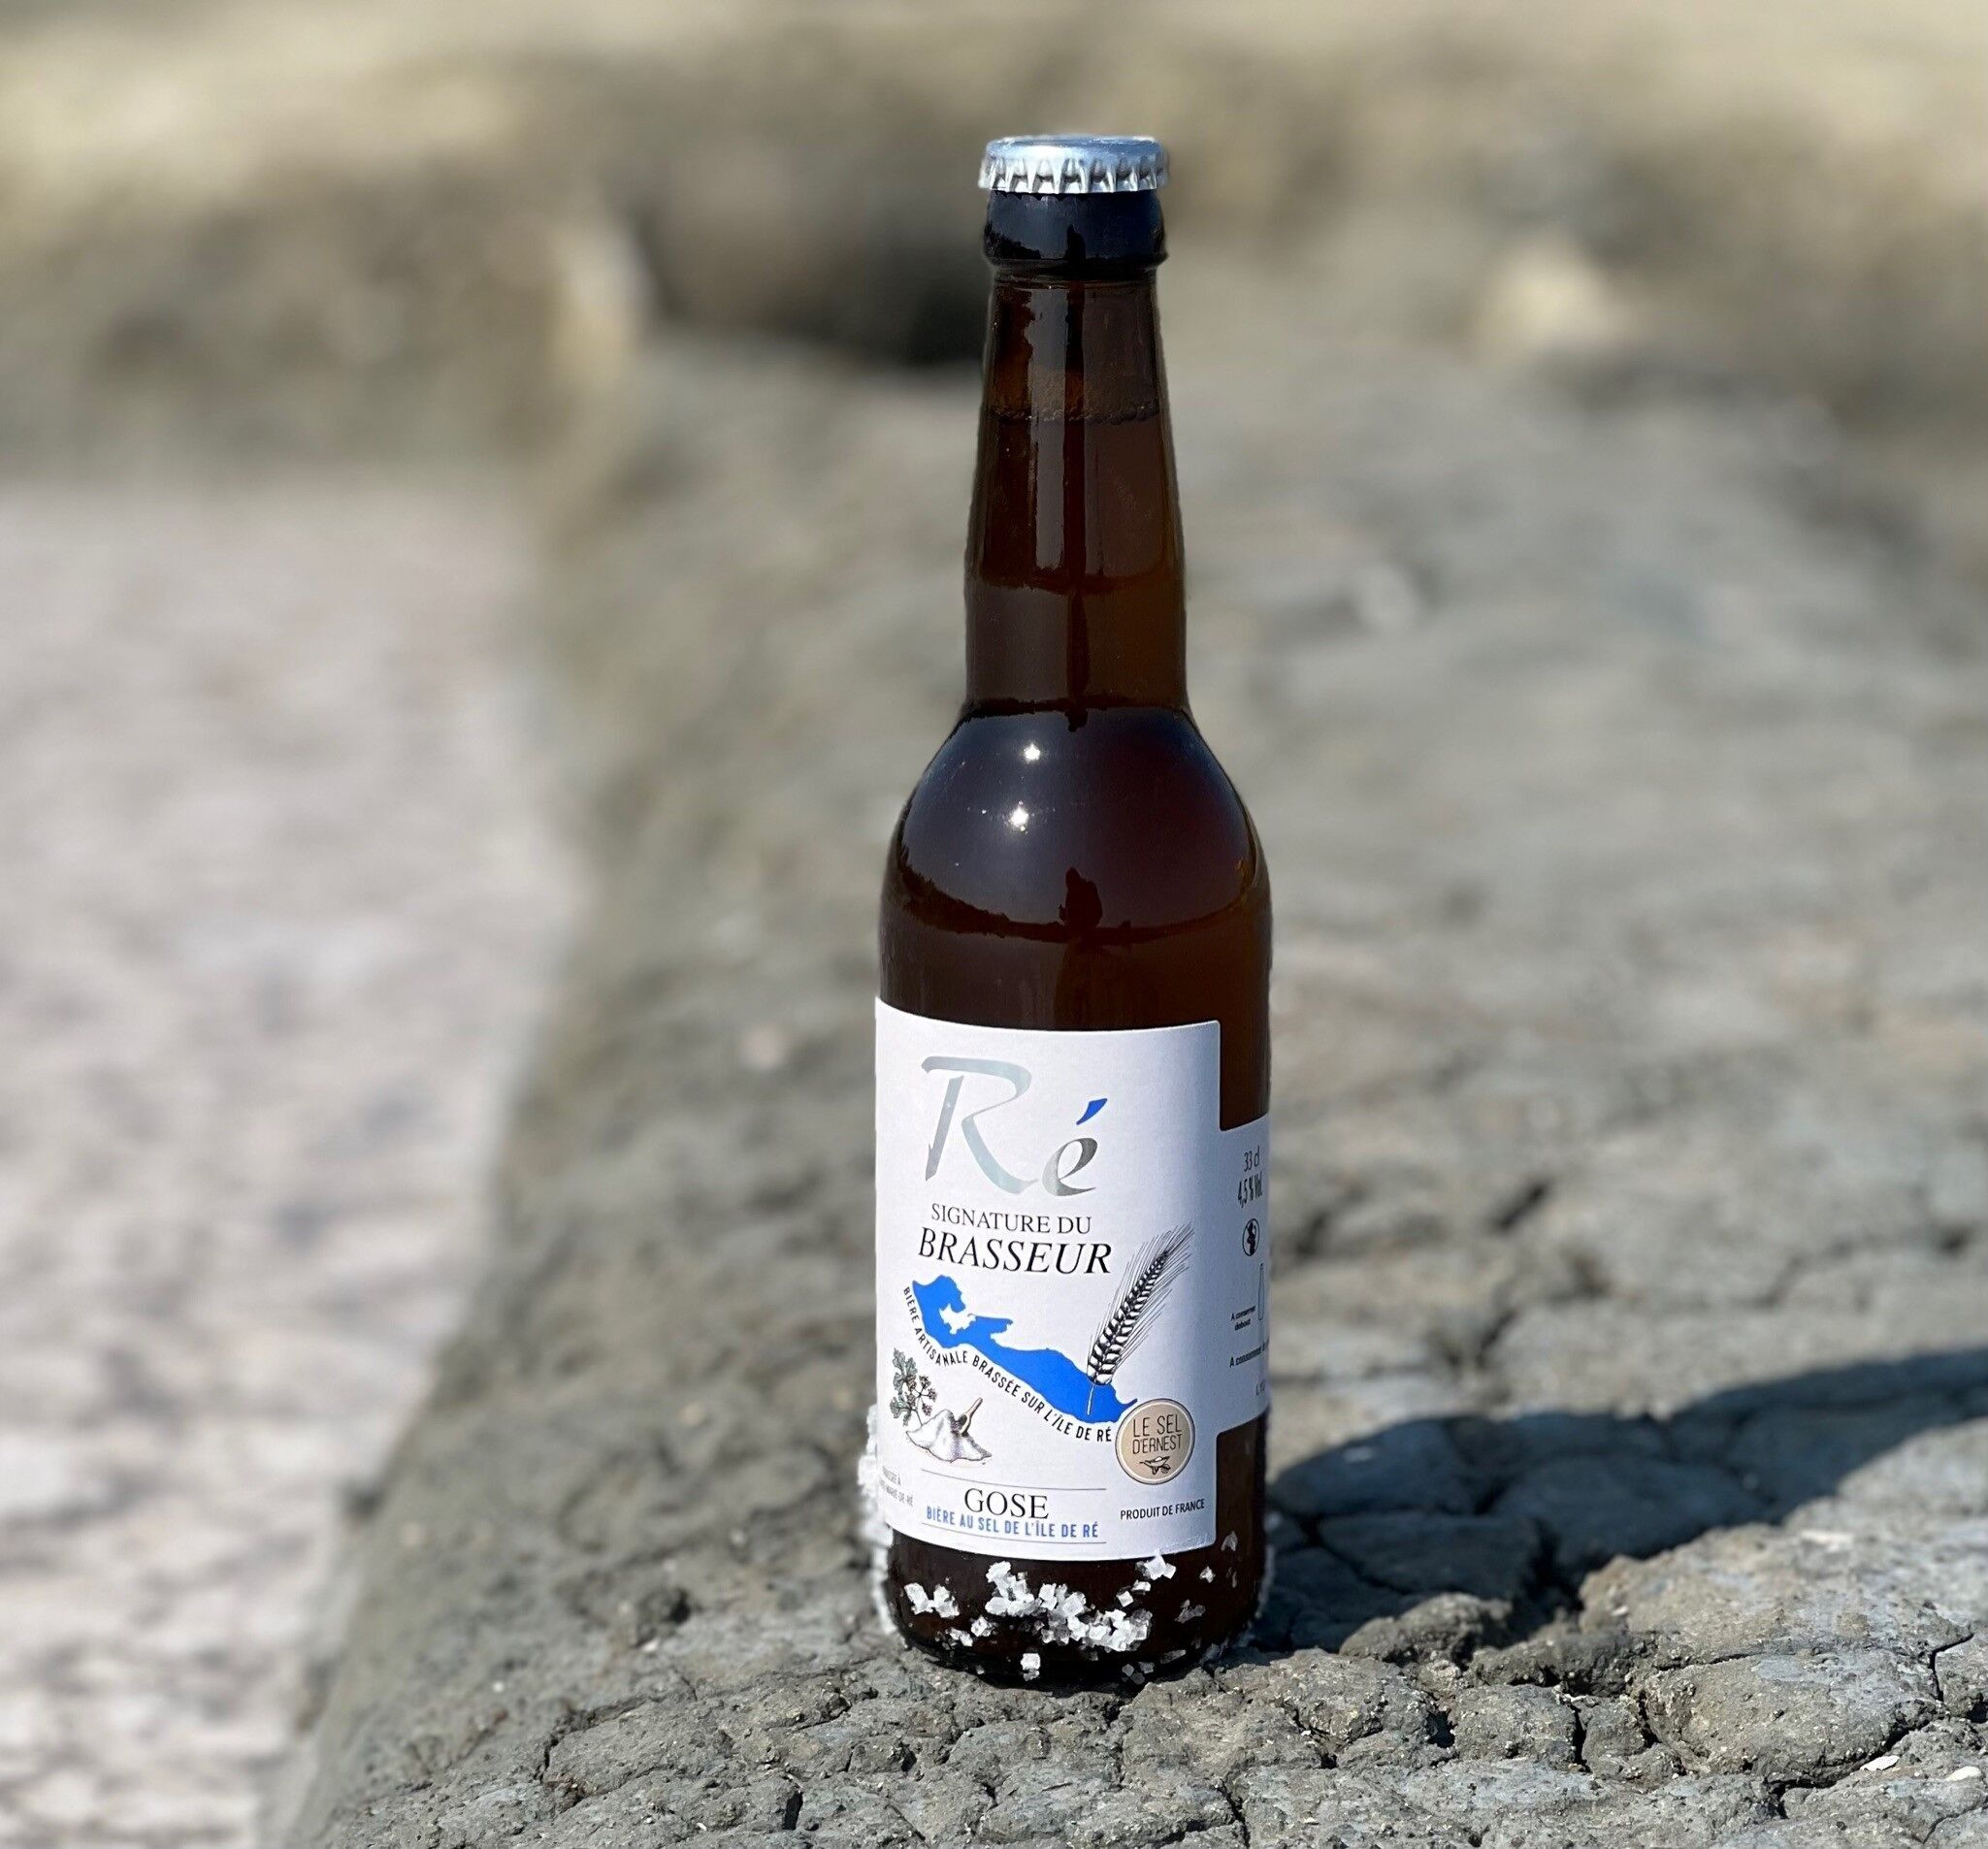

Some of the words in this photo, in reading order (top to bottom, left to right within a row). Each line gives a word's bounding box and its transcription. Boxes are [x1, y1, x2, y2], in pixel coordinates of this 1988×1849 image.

[921, 1055, 1108, 1197] Ré
[1243, 1151, 1253, 1172] 33
[931, 1203, 1051, 1234] SIGNATURE
[1058, 1216, 1092, 1234] DU
[918, 1226, 1112, 1275] BRASSEUR
[914, 1326, 968, 1368] ARTISANALE
[972, 1354, 1022, 1398] BRASSÉE
[1021, 1391, 1045, 1414] SUR
[1076, 1425, 1092, 1441] DE
[1096, 1426, 1112, 1443] RÉ
[1132, 1417, 1151, 1438] LE
[1157, 1413, 1183, 1435] SEL
[1132, 1434, 1183, 1455] D'ERNEST
[963, 1487, 1050, 1520] GOSE
[1120, 1507, 1160, 1521] PRODUIT
[1161, 1505, 1174, 1516] DE
[1175, 1498, 1205, 1514] FRANCE
[926, 1505, 956, 1526] BIÈRE
[960, 1512, 974, 1529] AU
[978, 1516, 999, 1533] SEL
[1004, 1520, 1020, 1535] DE
[1025, 1519, 1056, 1538] L'ÎLE
[1061, 1524, 1077, 1539] DE
[1082, 1521, 1098, 1539] RÉ
